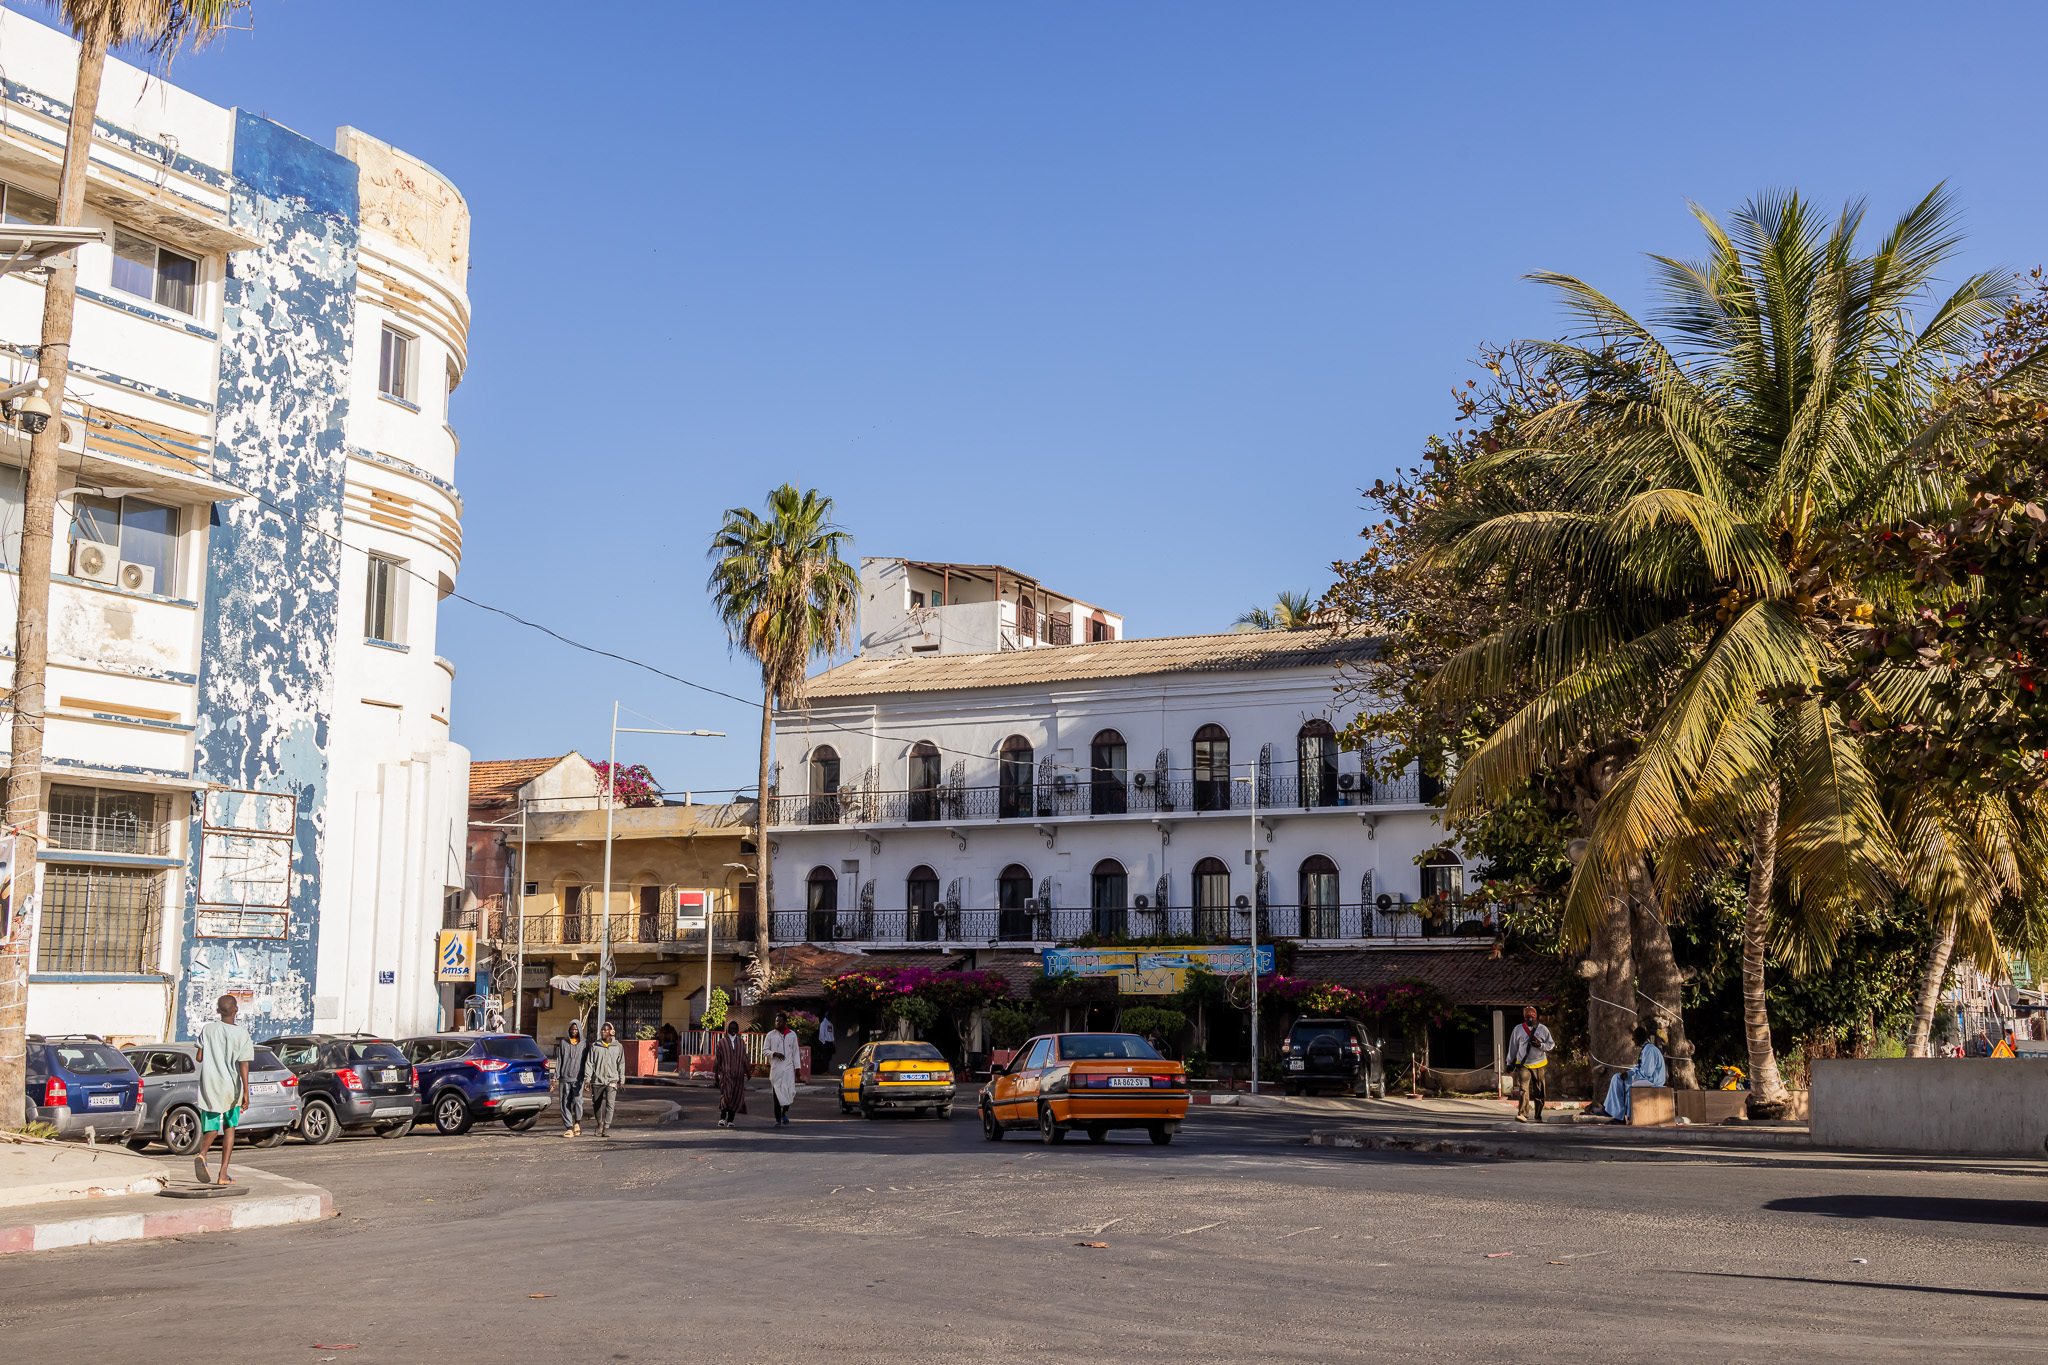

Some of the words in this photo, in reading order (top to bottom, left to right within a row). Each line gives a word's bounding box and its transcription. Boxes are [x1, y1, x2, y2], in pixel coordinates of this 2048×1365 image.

[441, 967, 470, 975] AMSA
[1046, 955, 1107, 977] HOTEL
[1120, 973, 1144, 993] DE
